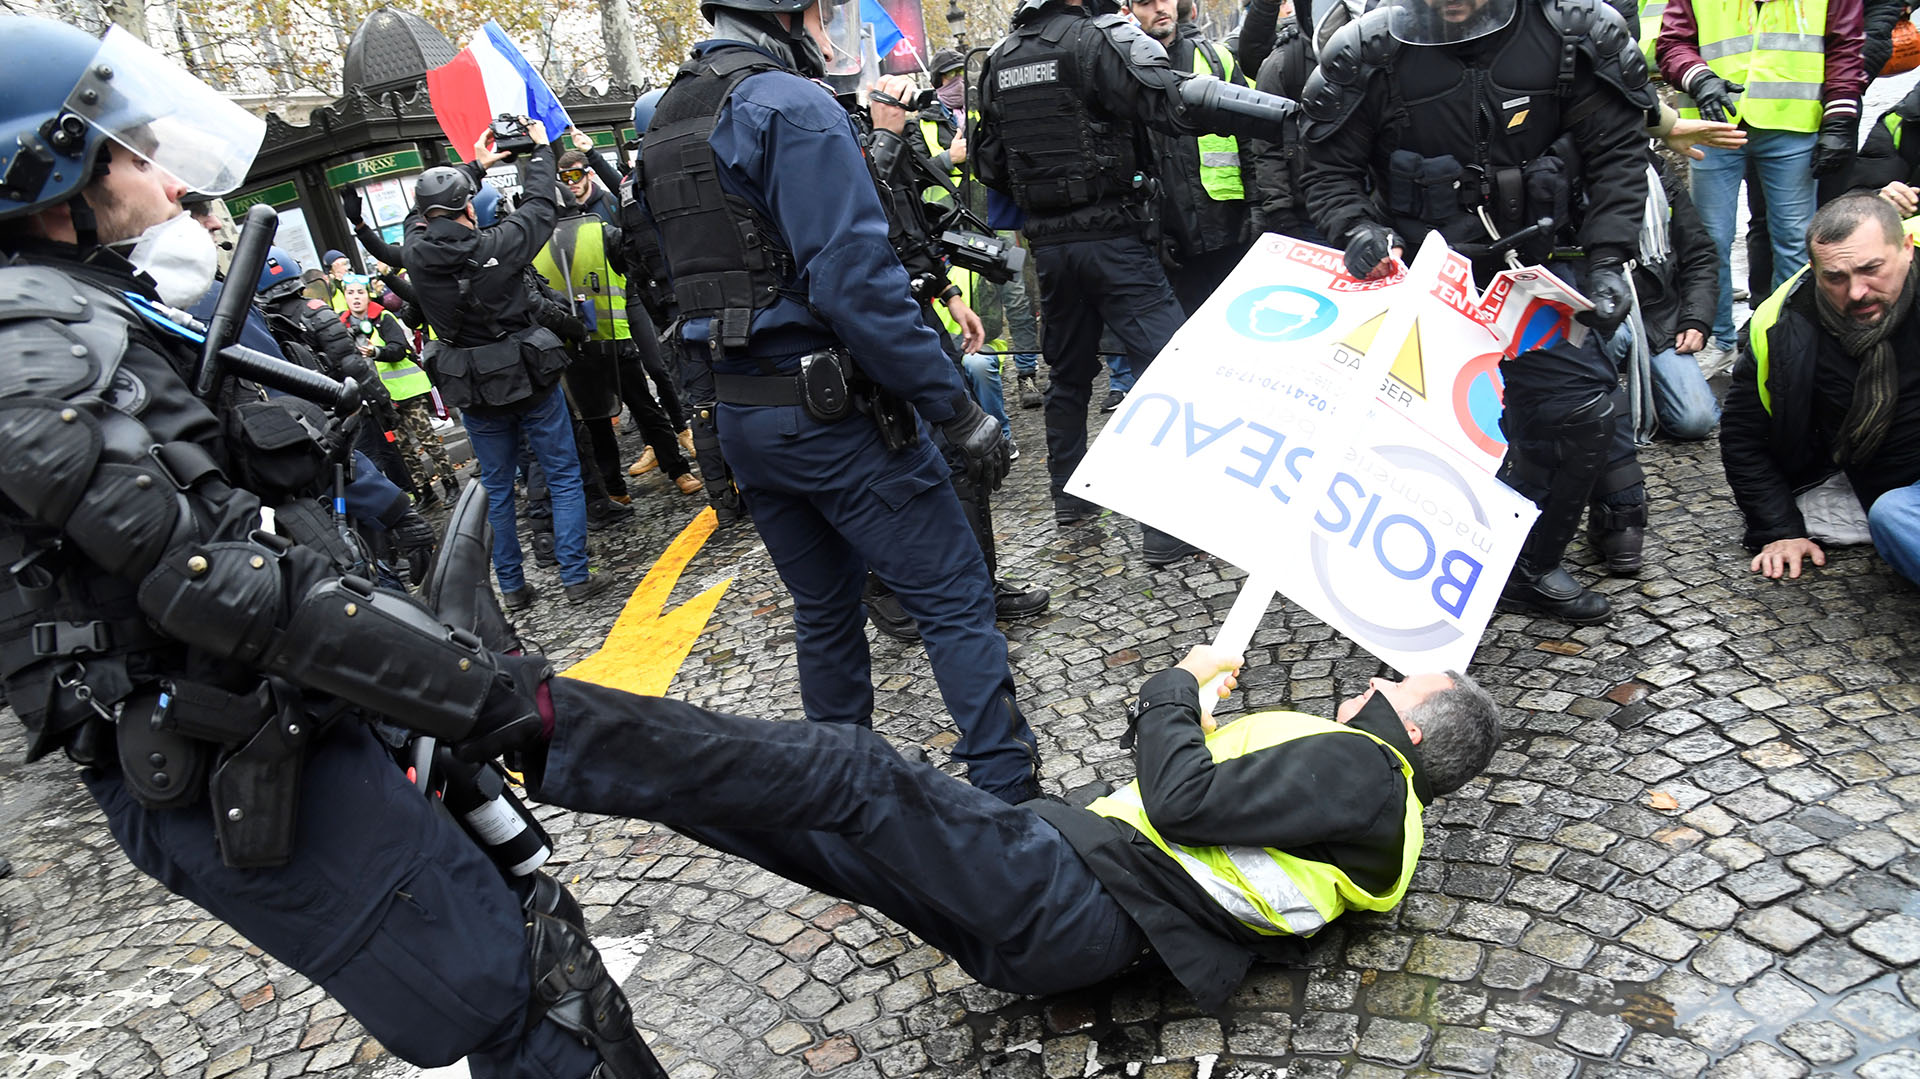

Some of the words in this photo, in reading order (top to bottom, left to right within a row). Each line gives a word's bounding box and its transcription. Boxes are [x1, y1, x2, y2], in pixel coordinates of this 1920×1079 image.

[998, 62, 1057, 89] GENDARMERIE
[357, 155, 398, 175] PRESSE
[1290, 247, 1351, 276] CHAN
[1333, 348, 1413, 408] DAGER
[1113, 391, 1484, 620] BOISSEAU
